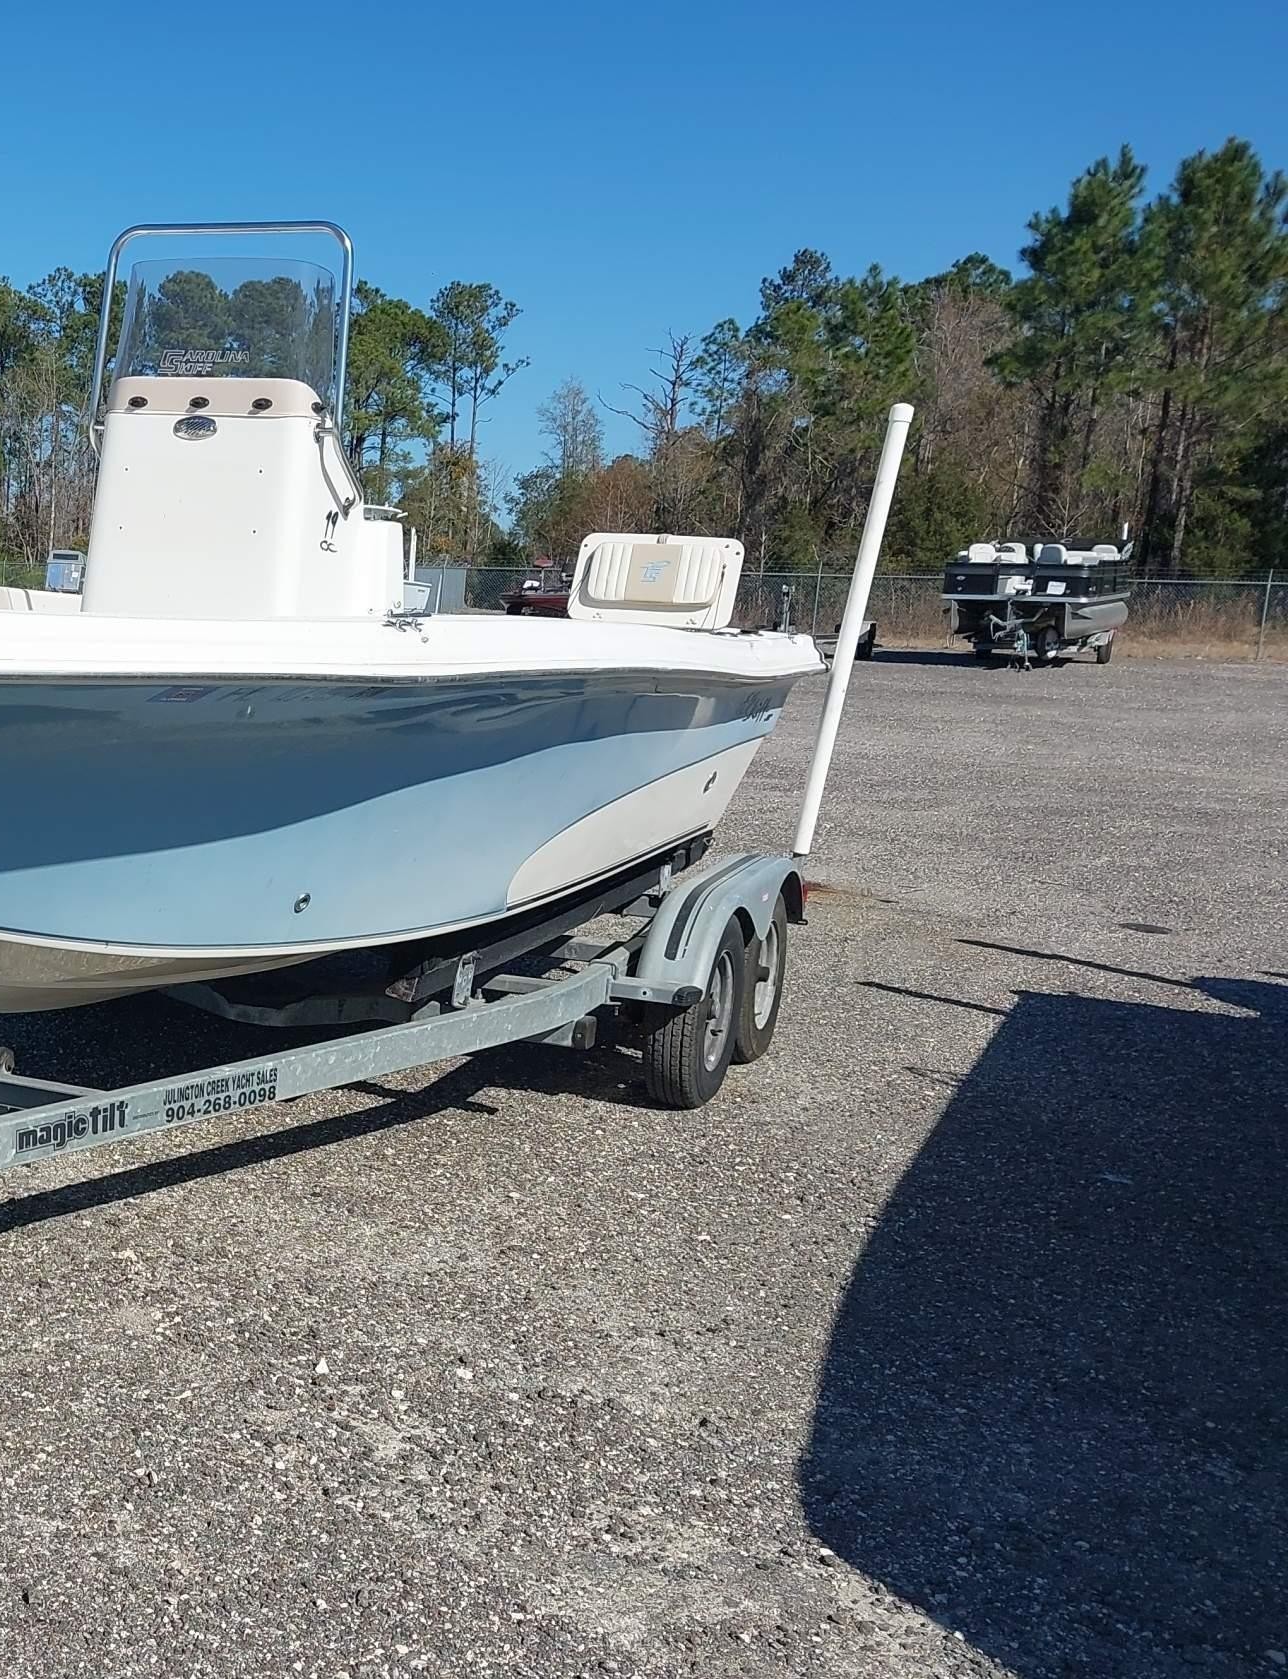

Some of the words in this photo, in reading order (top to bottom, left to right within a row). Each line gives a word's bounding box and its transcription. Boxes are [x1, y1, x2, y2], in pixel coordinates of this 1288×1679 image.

[158, 356, 213, 375] SKIFF
[160, 350, 250, 367] CAROLINA
[163, 1083, 205, 1106] JULINGTON
[206, 1078, 230, 1097] CREEK
[231, 1072, 255, 1092] YACHT
[255, 1067, 278, 1087] SALES
[165, 1086, 276, 1123] 904-268-0098
